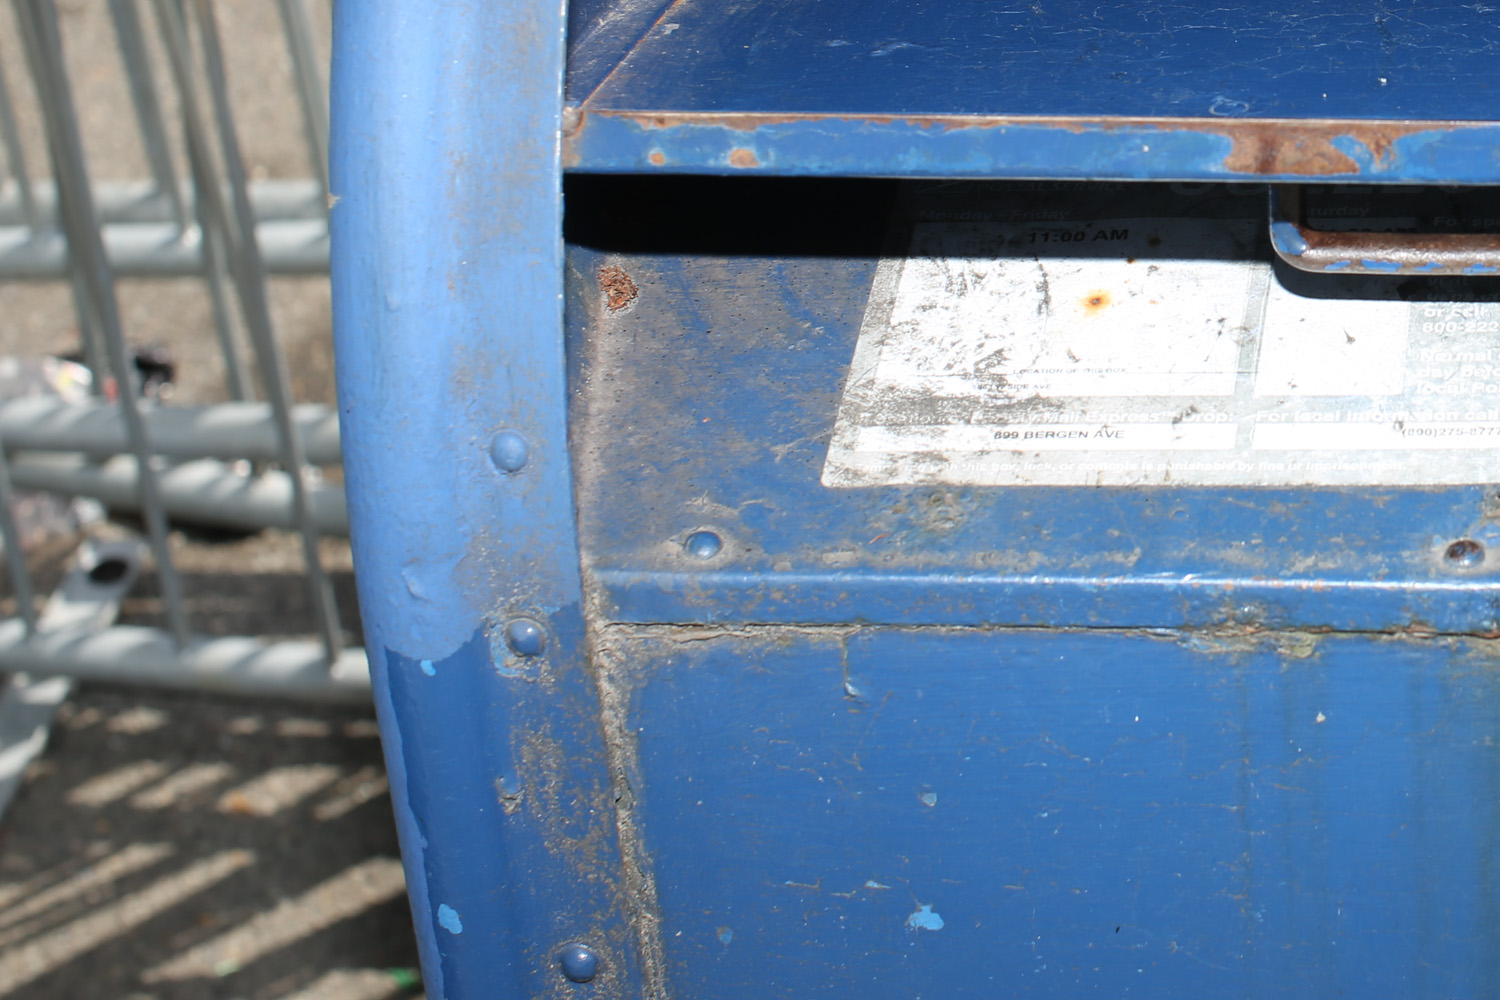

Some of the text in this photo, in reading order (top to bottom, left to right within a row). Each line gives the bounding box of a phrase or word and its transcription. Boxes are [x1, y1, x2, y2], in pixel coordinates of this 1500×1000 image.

[1051, 182, 1127, 192] SERVICE
[919, 208, 993, 222] Monday
[1011, 208, 1072, 222] Friday
[1027, 231, 1087, 243] 11:00
[1092, 229, 1130, 241] AM
[1256, 410, 1288, 423] For
[994, 429, 1126, 440] 899 BERGEN AVE
